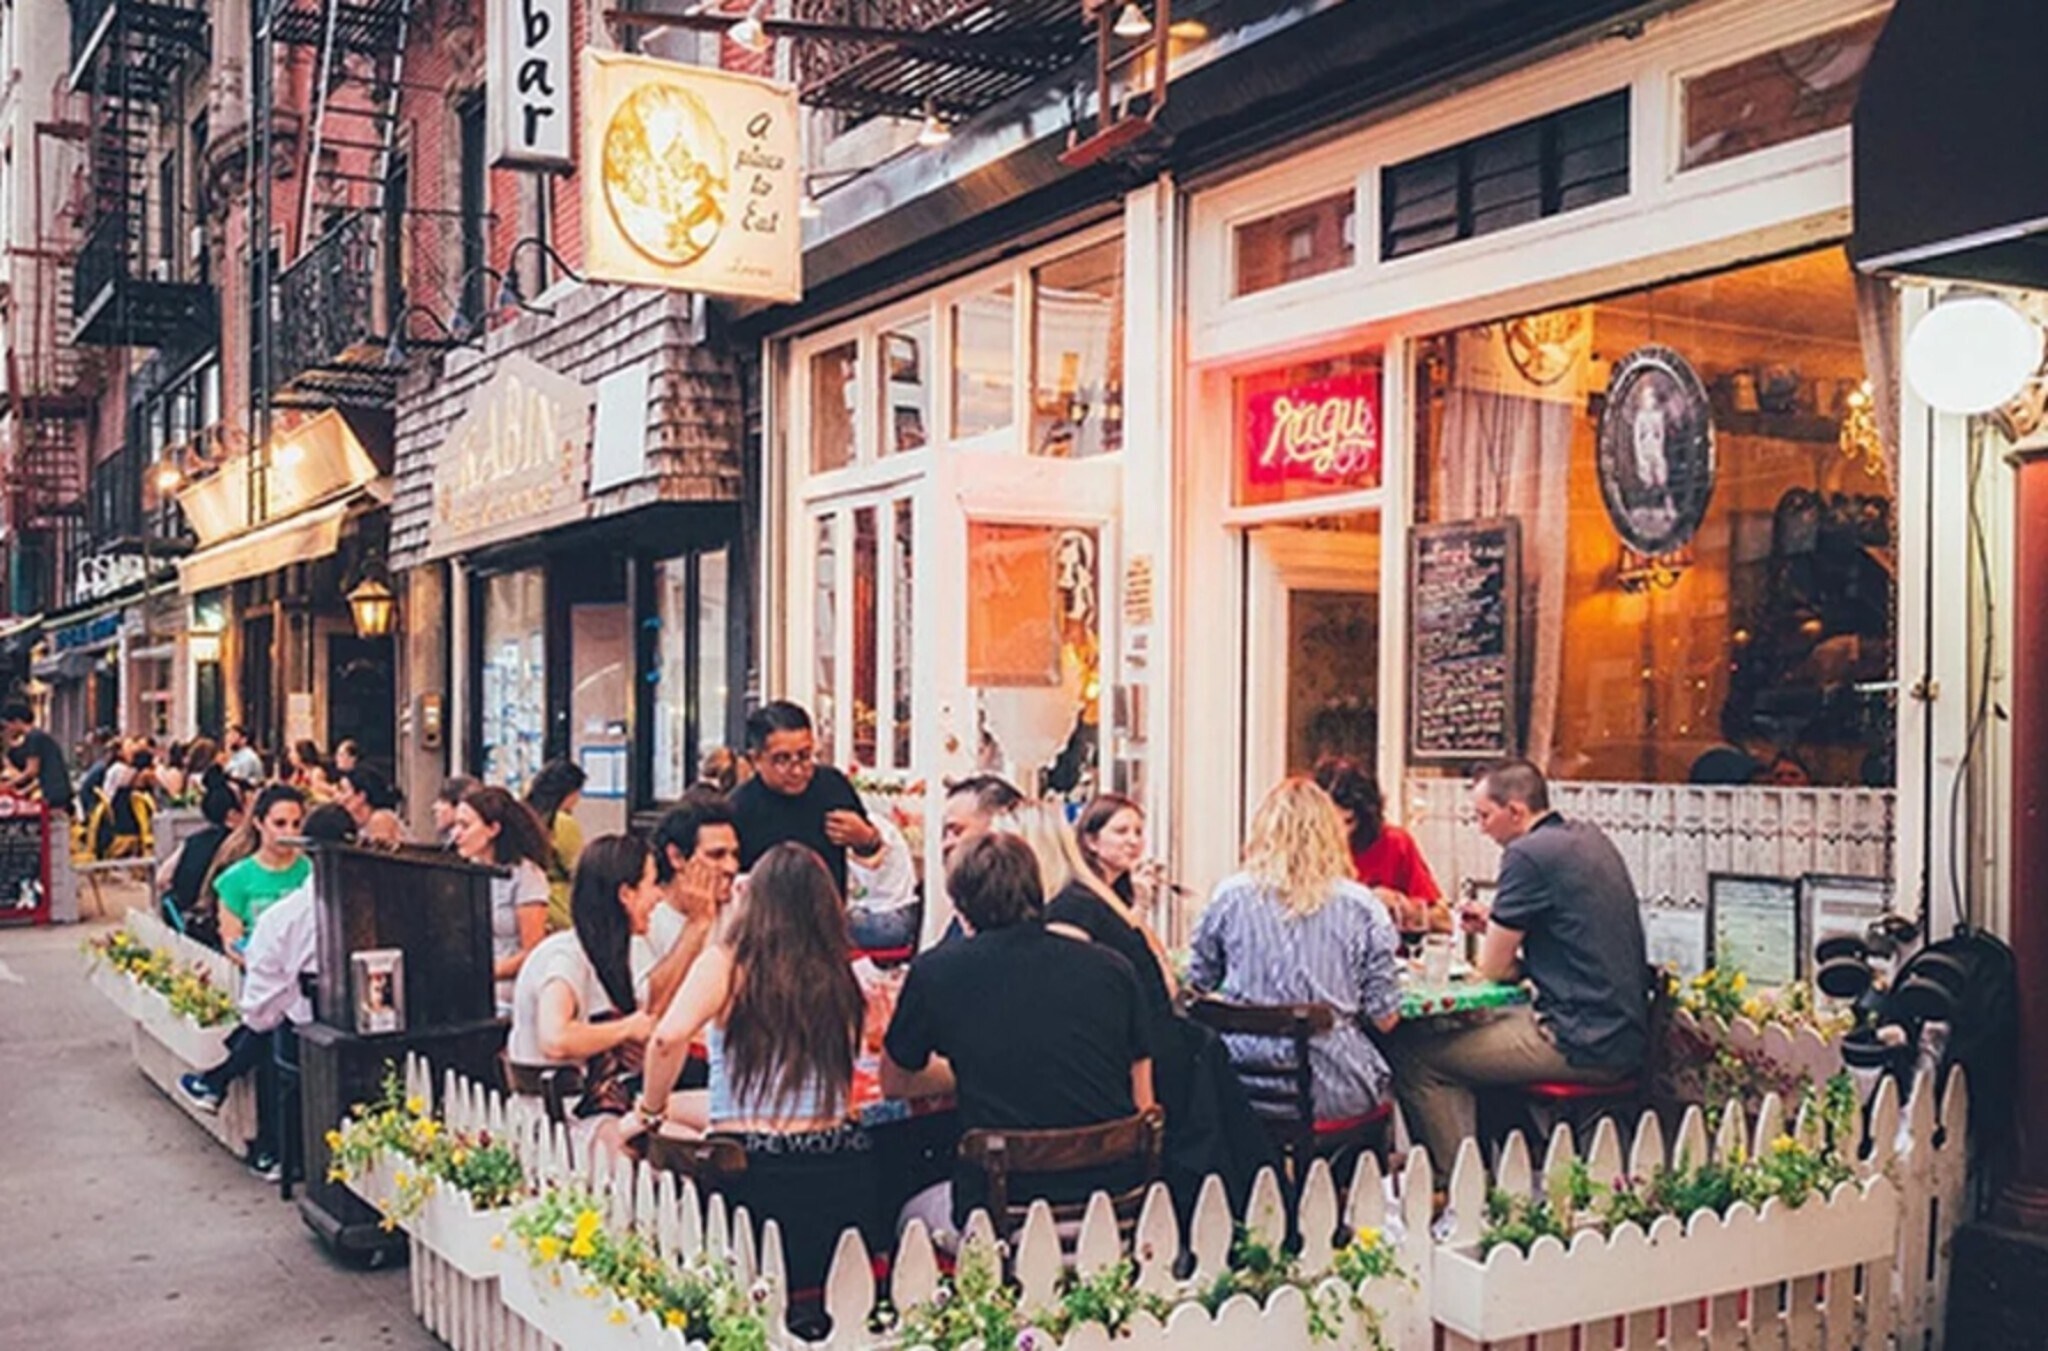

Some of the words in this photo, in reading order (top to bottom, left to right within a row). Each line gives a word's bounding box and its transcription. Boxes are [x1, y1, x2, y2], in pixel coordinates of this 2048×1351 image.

[518, 0, 553, 146] bar
[746, 112, 773, 140] a
[750, 173, 773, 197] to
